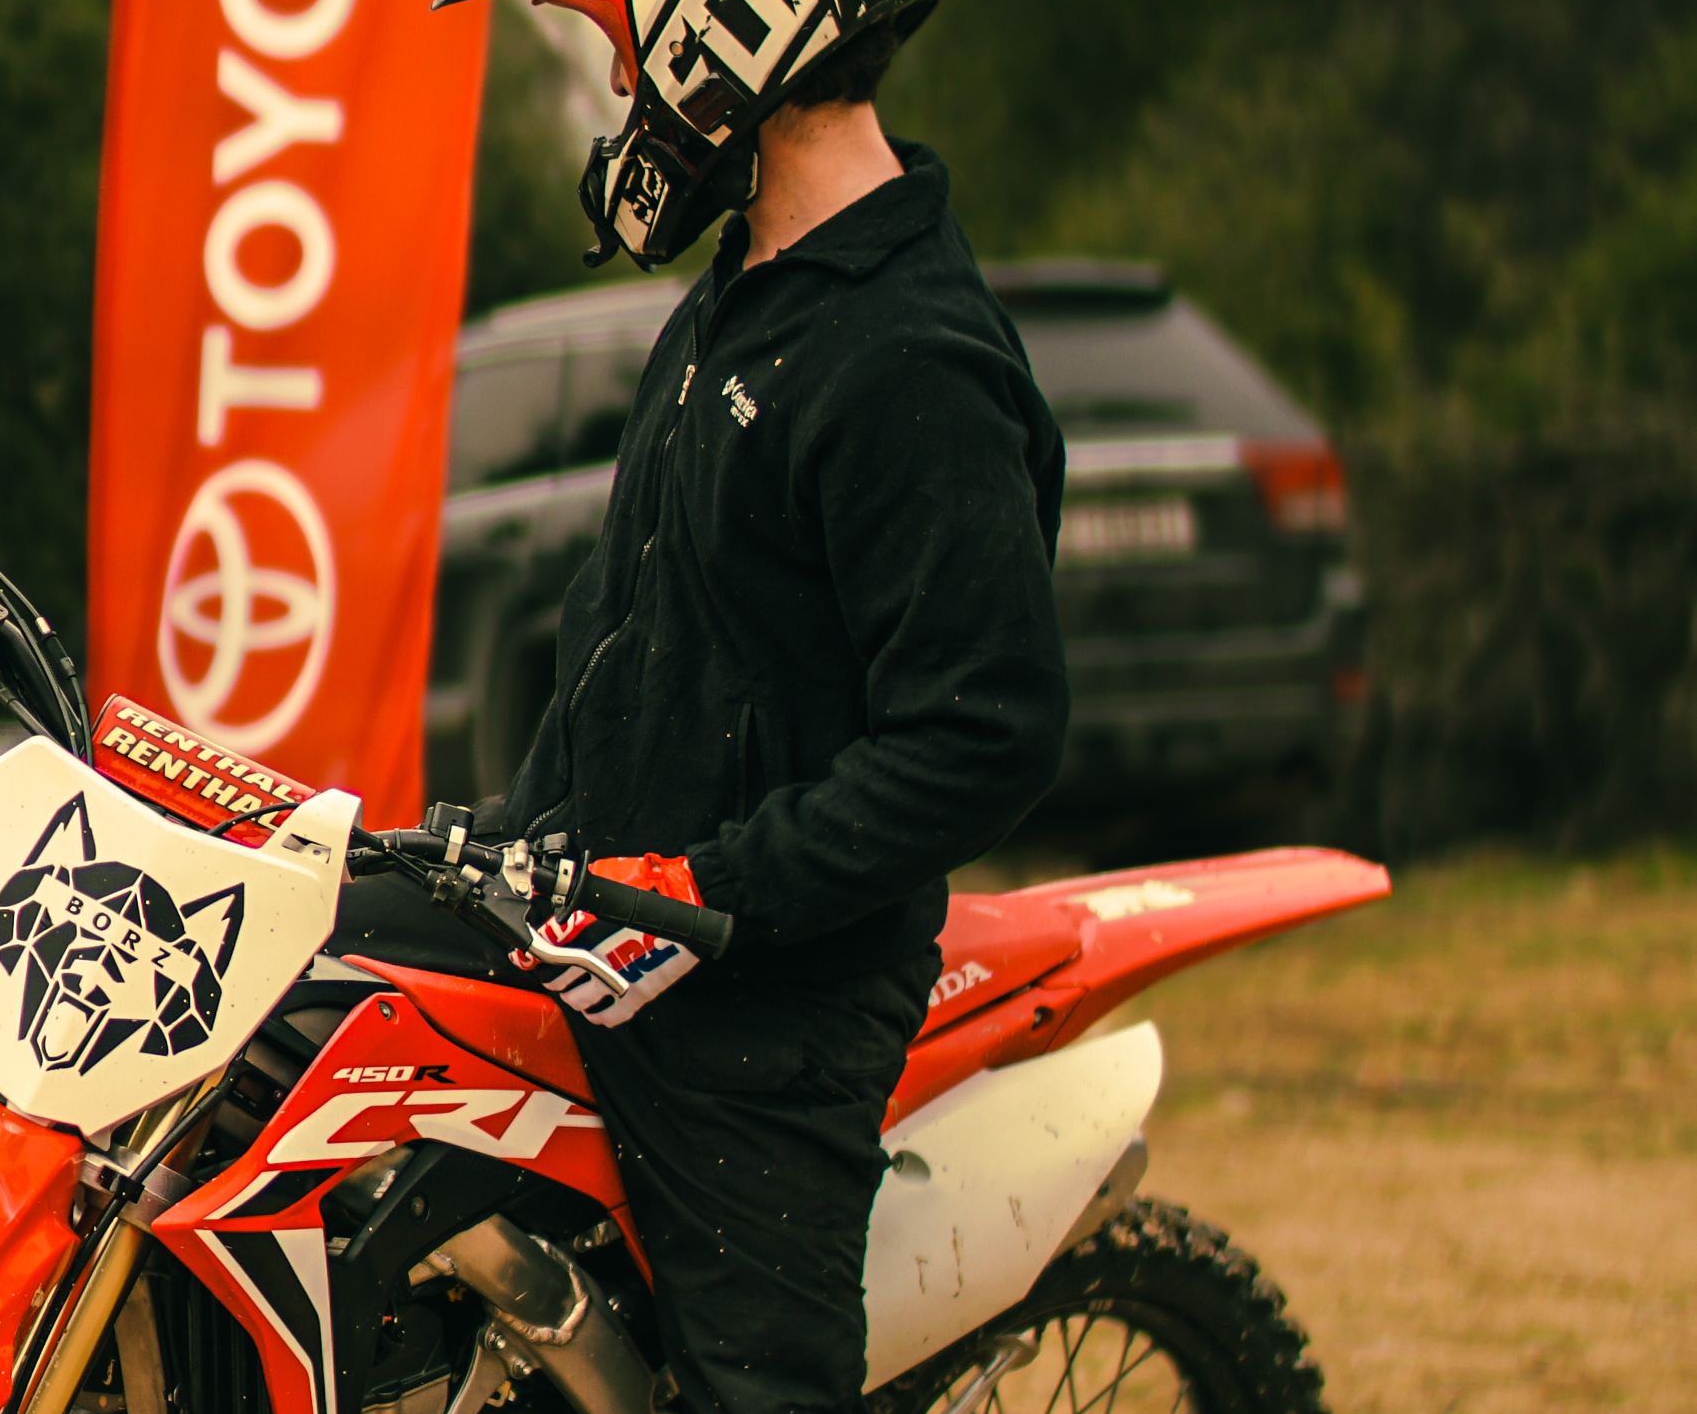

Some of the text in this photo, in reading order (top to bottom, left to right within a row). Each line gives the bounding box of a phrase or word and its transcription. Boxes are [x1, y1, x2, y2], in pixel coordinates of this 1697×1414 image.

[115, 706, 298, 804] RENTHAL
[63, 893, 171, 971] BORZ
[332, 1064, 457, 1086] 450R
